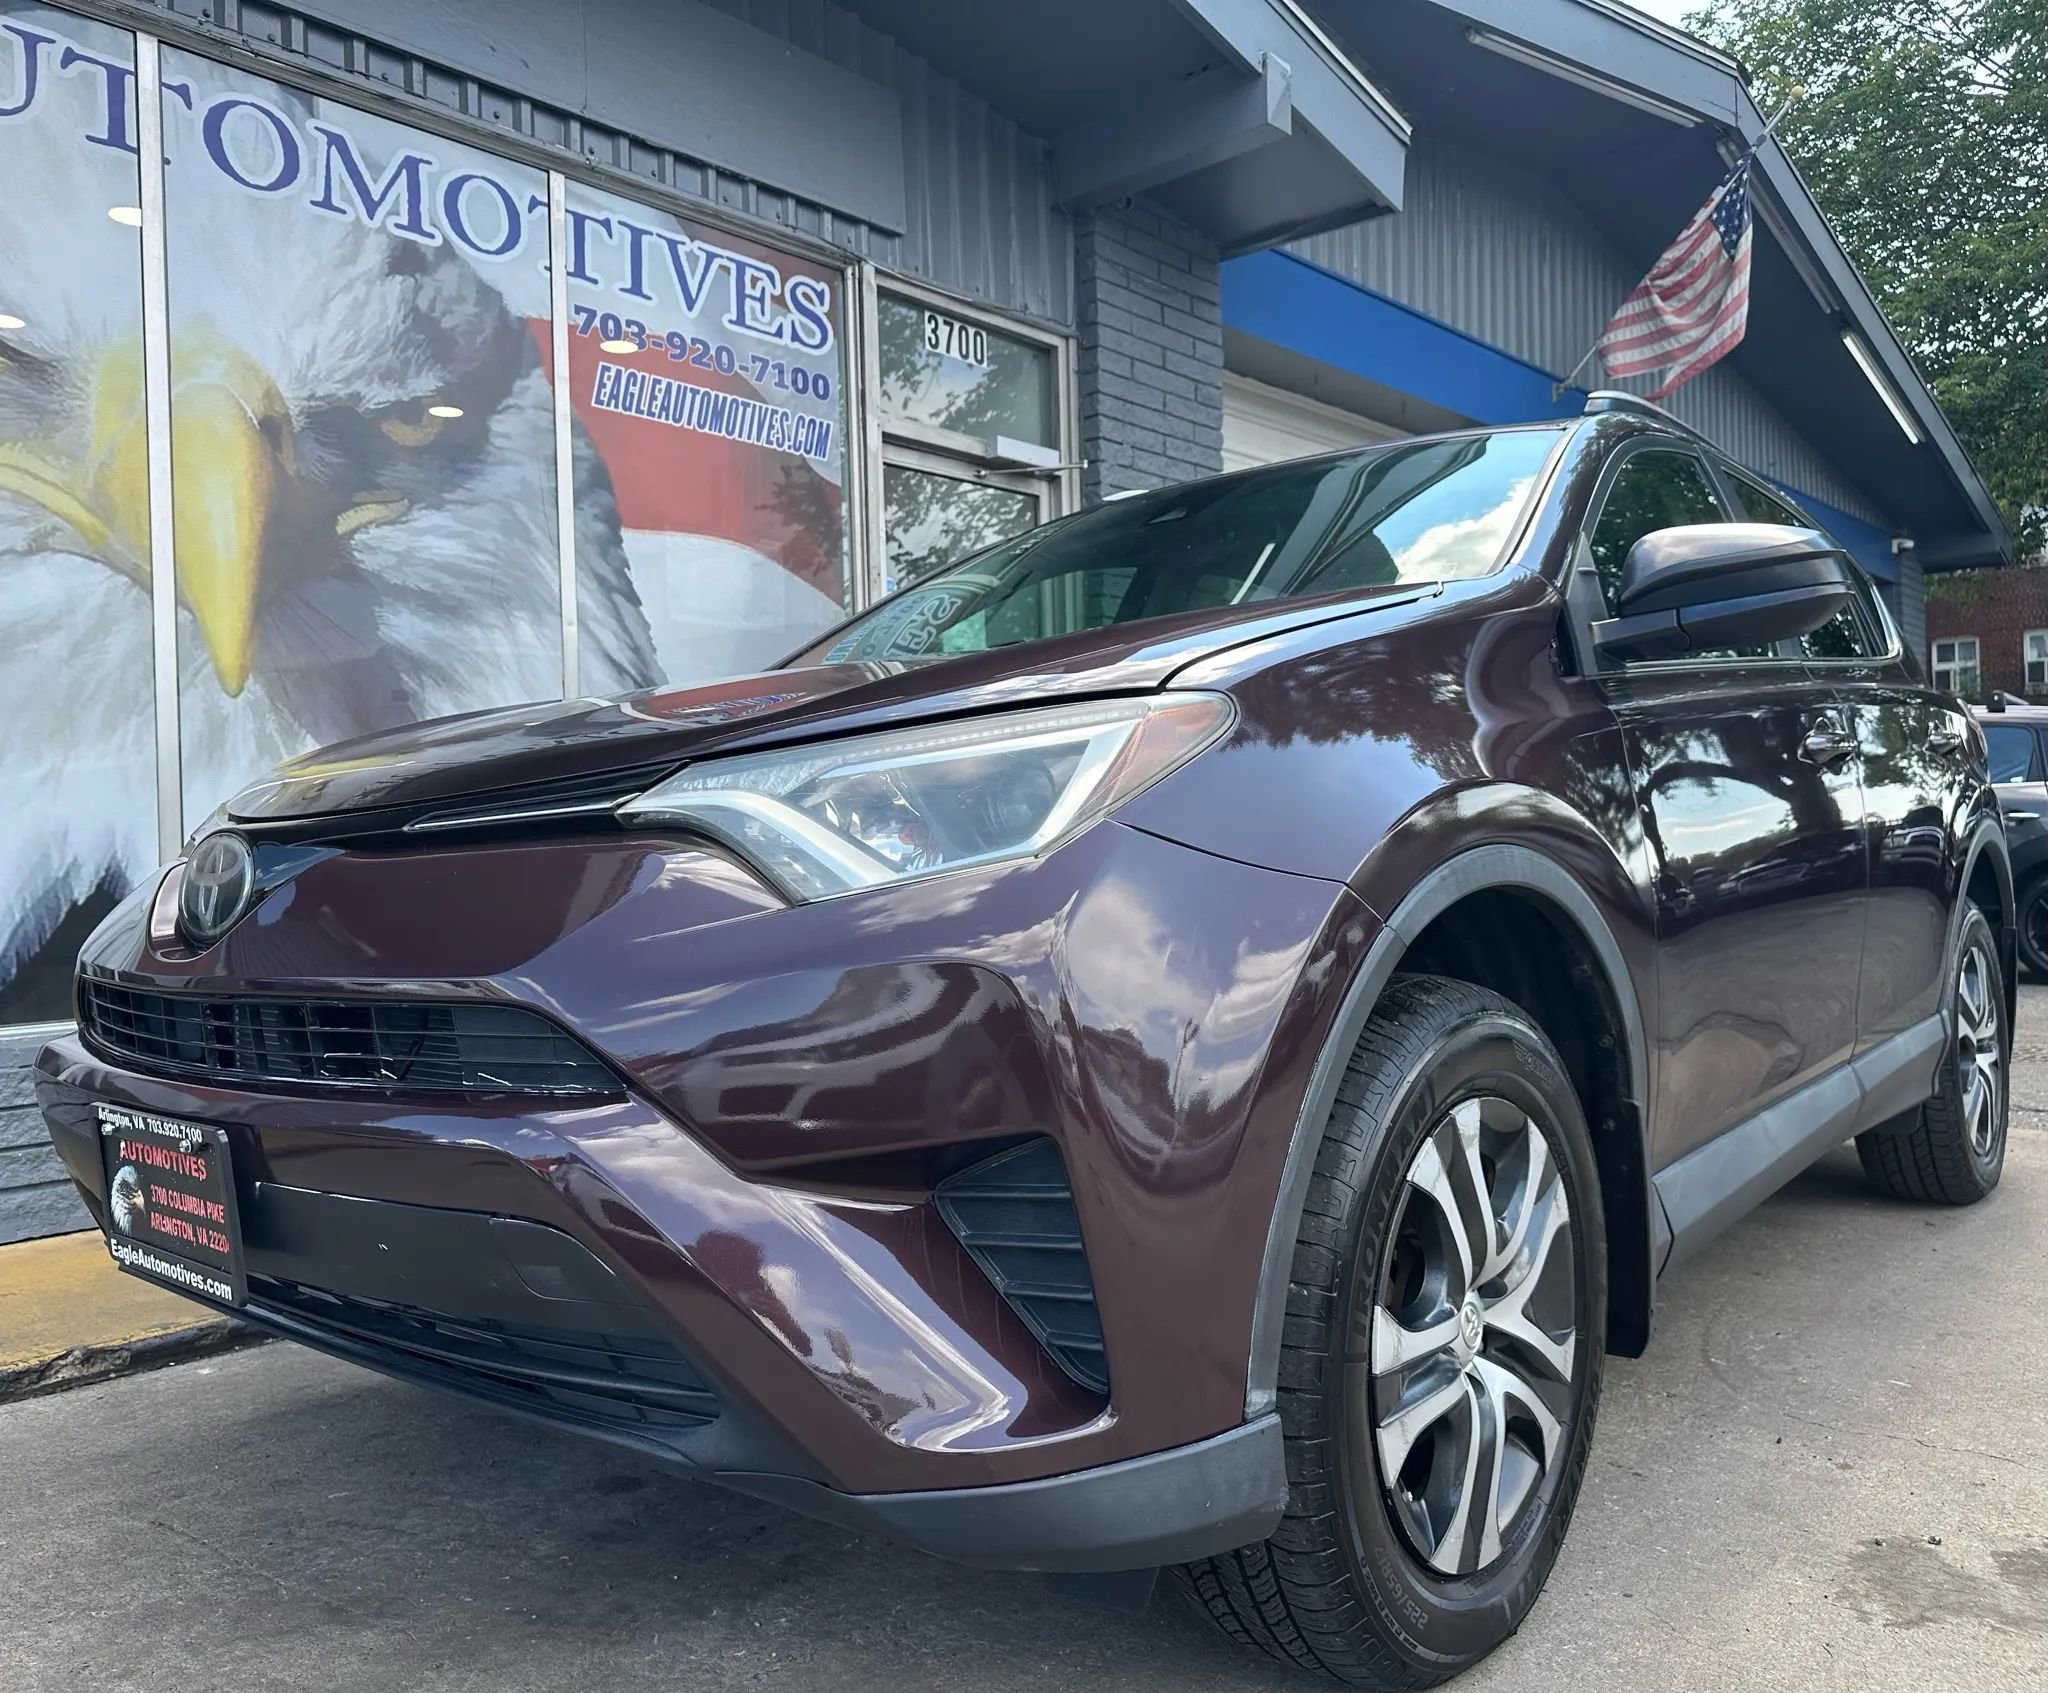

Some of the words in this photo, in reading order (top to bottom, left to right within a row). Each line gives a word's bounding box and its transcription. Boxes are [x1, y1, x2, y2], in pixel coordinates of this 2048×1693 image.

[573, 303, 831, 401] 703-920-7100
[926, 313, 985, 366] 3700
[593, 363, 832, 459] EAGLEAUTOMOTIVES.COM
[98, 1107, 132, 1130] Arlington,
[132, 1114, 146, 1130] VA
[147, 1118, 203, 1143] 703.920.7100
[120, 1139, 207, 1181] AUTOMOTIVES
[150, 1184, 168, 1206] 3700
[168, 1189, 206, 1218] COLUMBIA
[206, 1200, 225, 1224] PIKE
[196, 1225, 208, 1247] VA
[209, 1229, 230, 1254] 2220
[110, 1238, 233, 1301] EagleAutomotives.com
